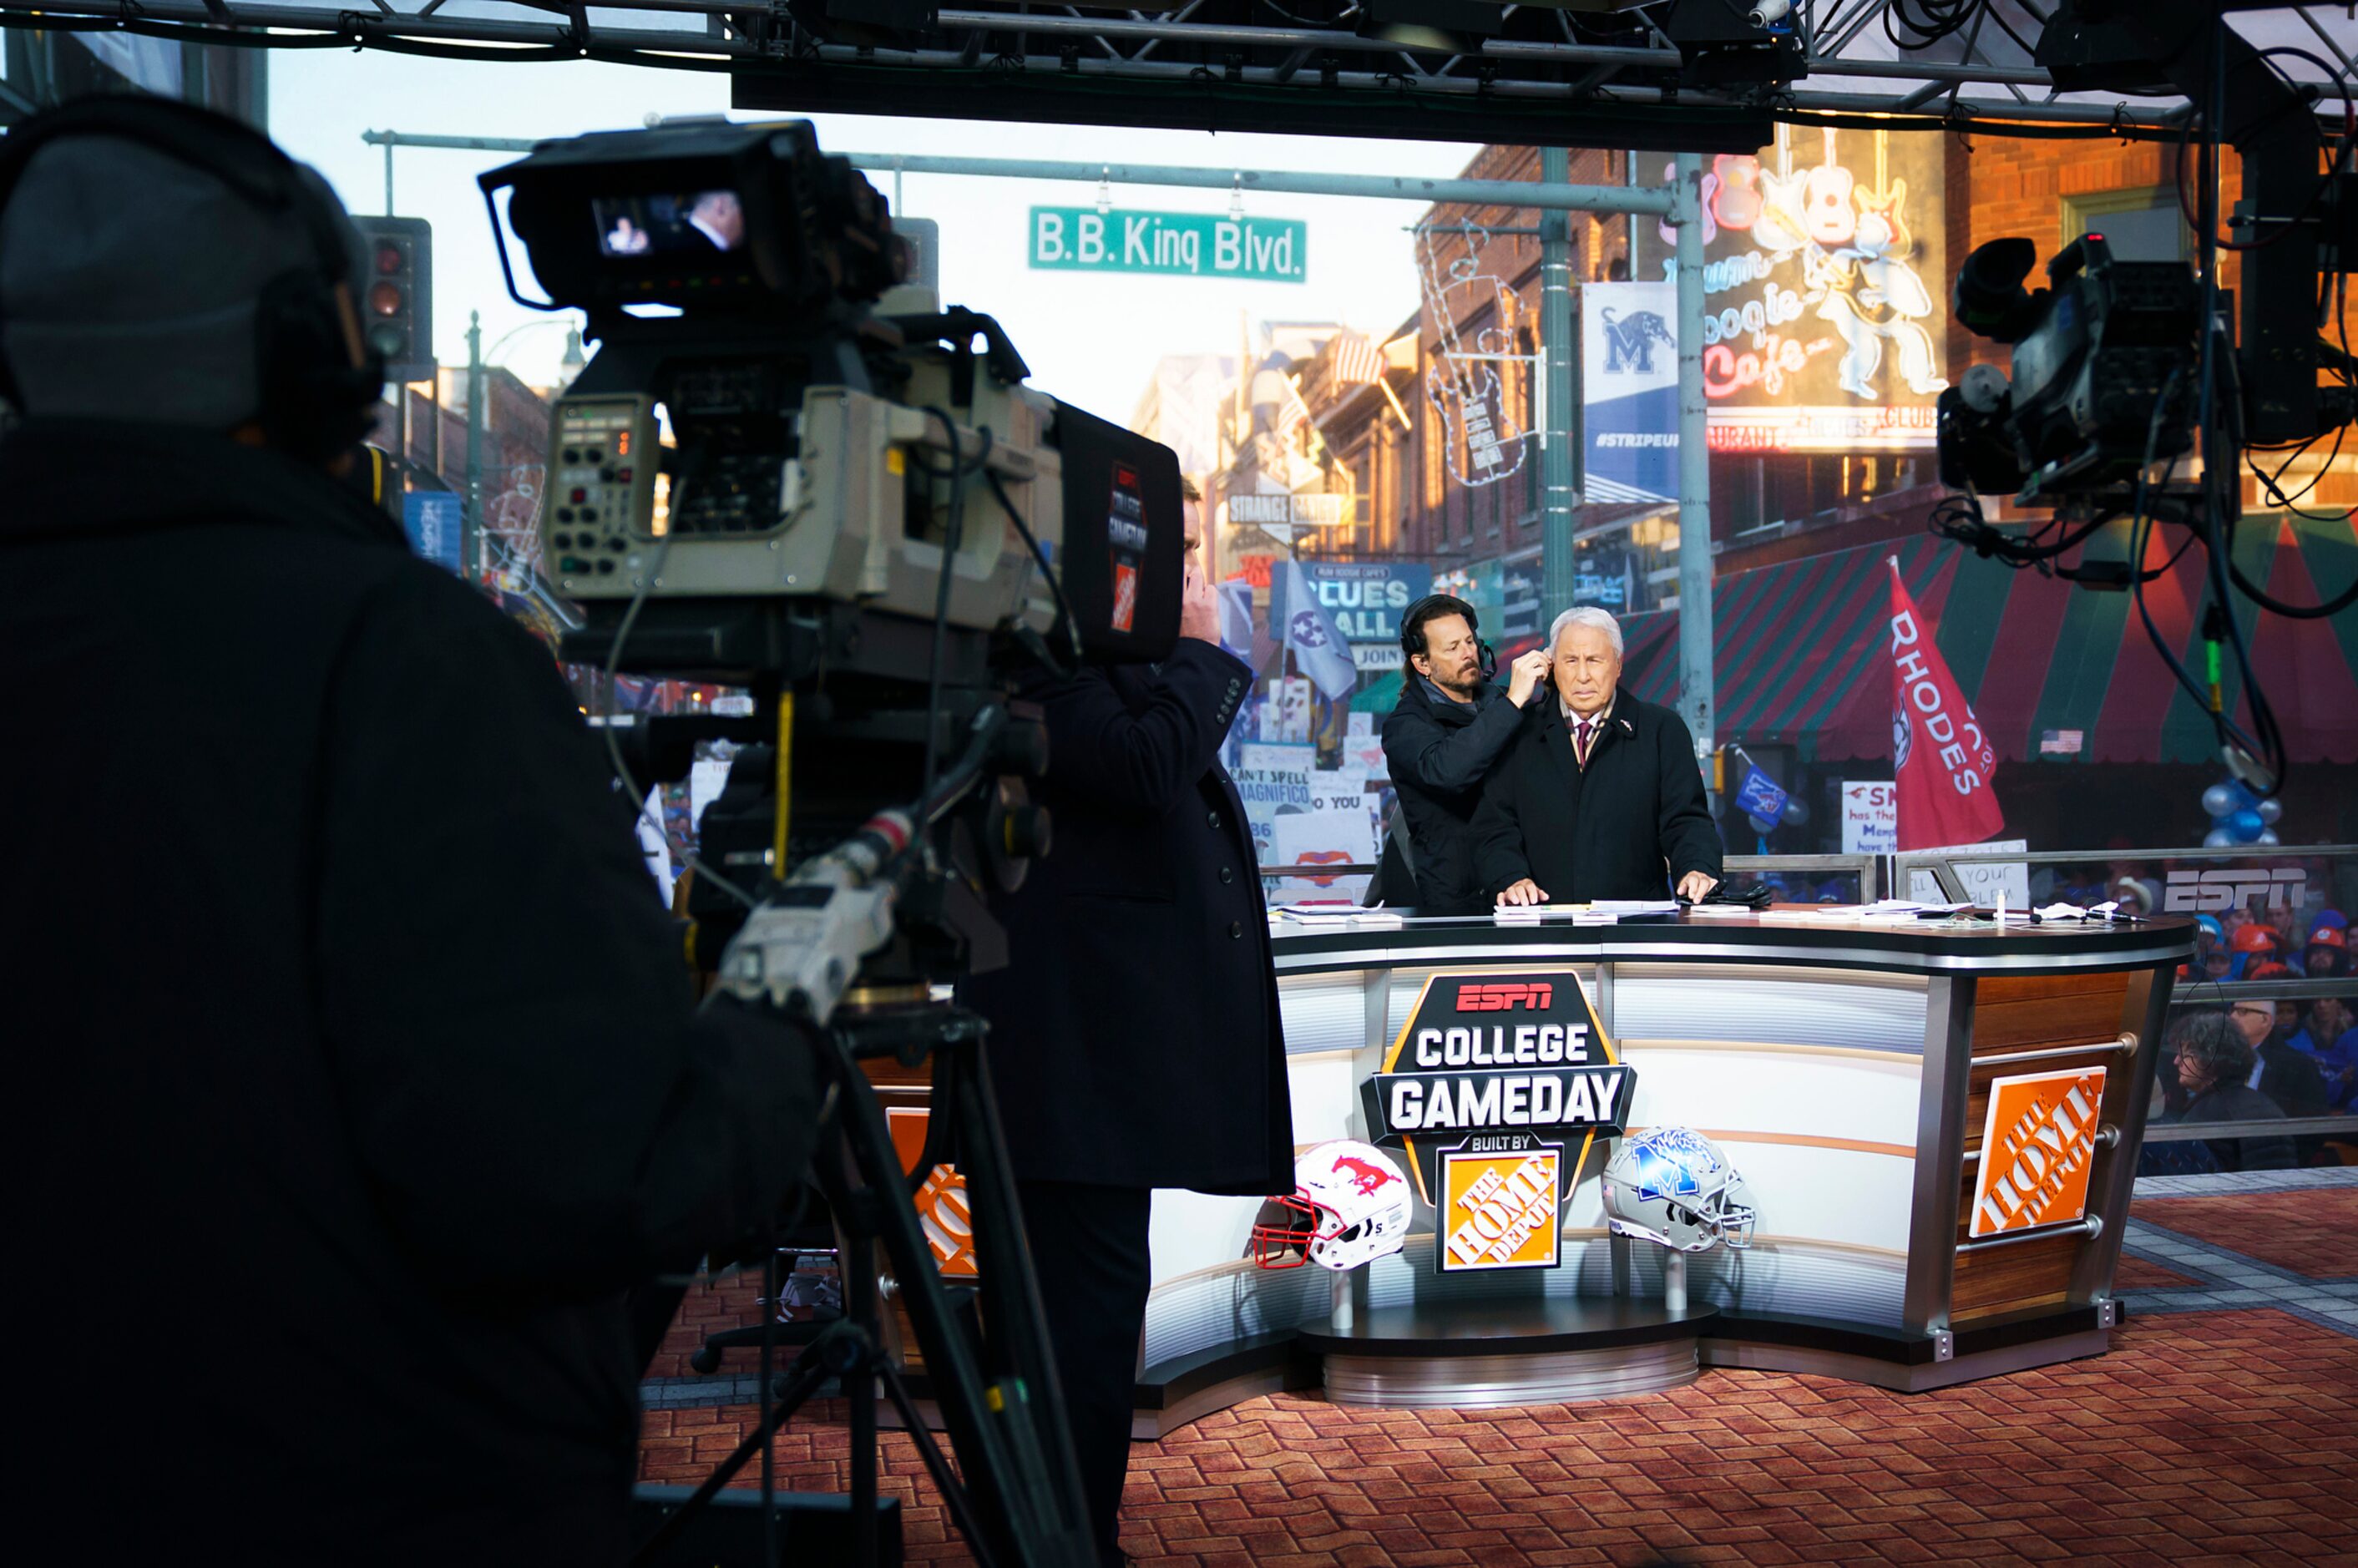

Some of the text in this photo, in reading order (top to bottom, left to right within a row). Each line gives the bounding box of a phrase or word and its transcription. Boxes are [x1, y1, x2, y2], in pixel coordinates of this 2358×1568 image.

[1037, 213, 1301, 275] B.B. King Blvd.
[1705, 282, 1804, 350] oogie
[1704, 334, 1807, 398] Cafe
[1308, 580, 1409, 608] LUES
[1334, 610, 1395, 638] ALL
[1890, 609, 1981, 796] RHODES
[1230, 769, 1263, 782] CAN'T
[1271, 769, 1308, 785] SPELL
[1312, 796, 1360, 810] O YOU
[1849, 809, 1895, 821] has the
[1858, 841, 1882, 852] have
[1863, 824, 1897, 840] Memp
[2163, 868, 2307, 913] ESPN
[1455, 983, 1553, 1012] ESPN
[1415, 1023, 1589, 1068] COLLEGE
[1389, 1072, 1622, 1130] GAMEDAY
[1472, 1136, 1531, 1151] BUILT BY
[2001, 1092, 2052, 1157] THE
[1981, 1075, 2102, 1233] HOME
[2022, 1126, 2096, 1227] DEPOT
[1448, 1155, 1555, 1265] HOME
[1457, 1166, 1505, 1213] THE
[1488, 1192, 1555, 1263] DEPOT
